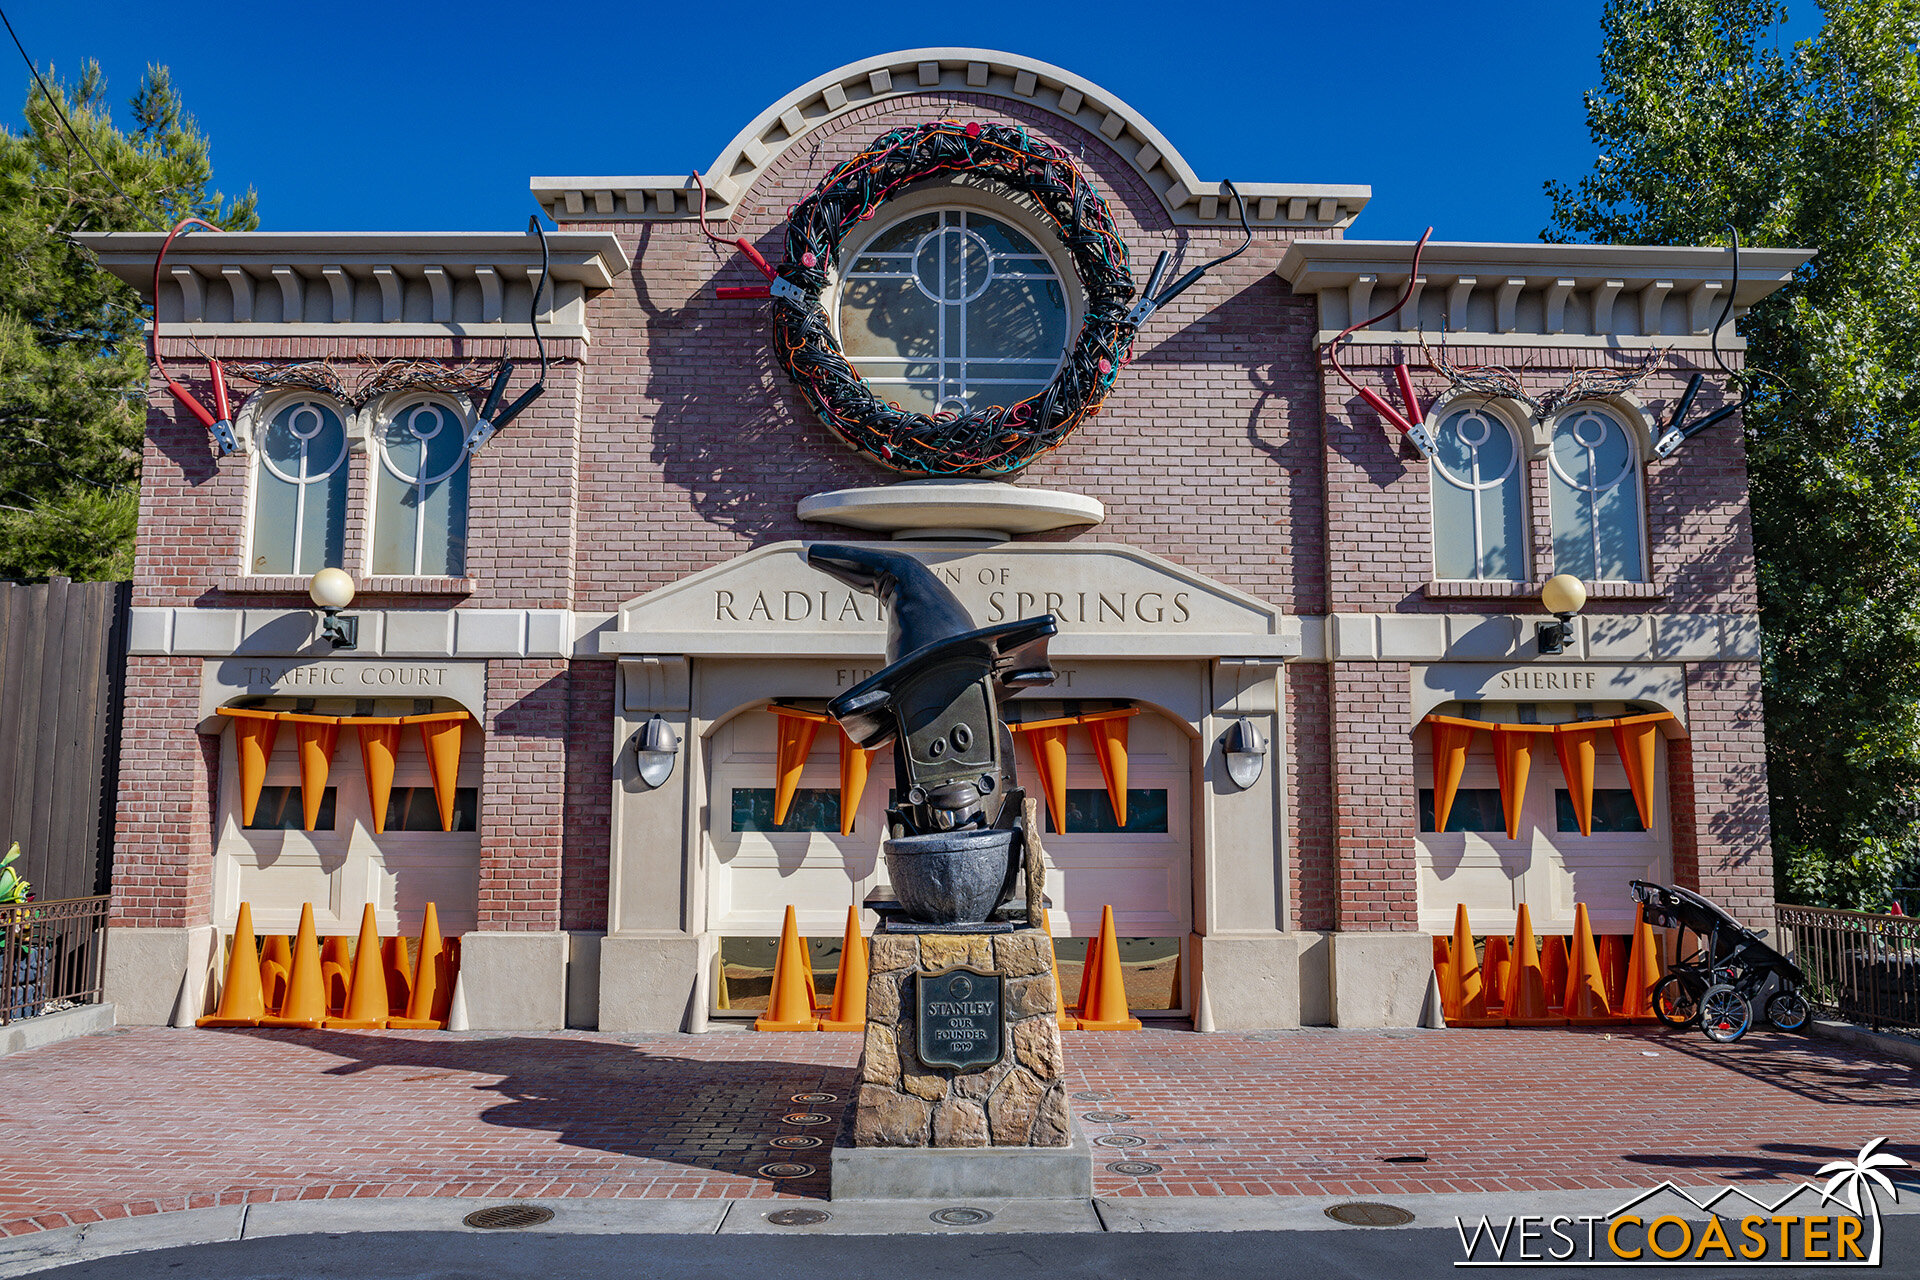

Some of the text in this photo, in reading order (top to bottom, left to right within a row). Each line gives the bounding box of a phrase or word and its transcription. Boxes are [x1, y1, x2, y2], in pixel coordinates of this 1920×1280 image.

[977, 567, 1011, 586] OF
[987, 591, 1191, 623] SPRINGS
[243, 666, 448, 686] TRAFFIC COURT
[1500, 671, 1596, 690] SHERIFF
[927, 1001, 994, 1016] STANLEY
[948, 1017, 973, 1028] OUR
[935, 1029, 987, 1040] FOUNDER
[950, 1041, 973, 1052] 1909
